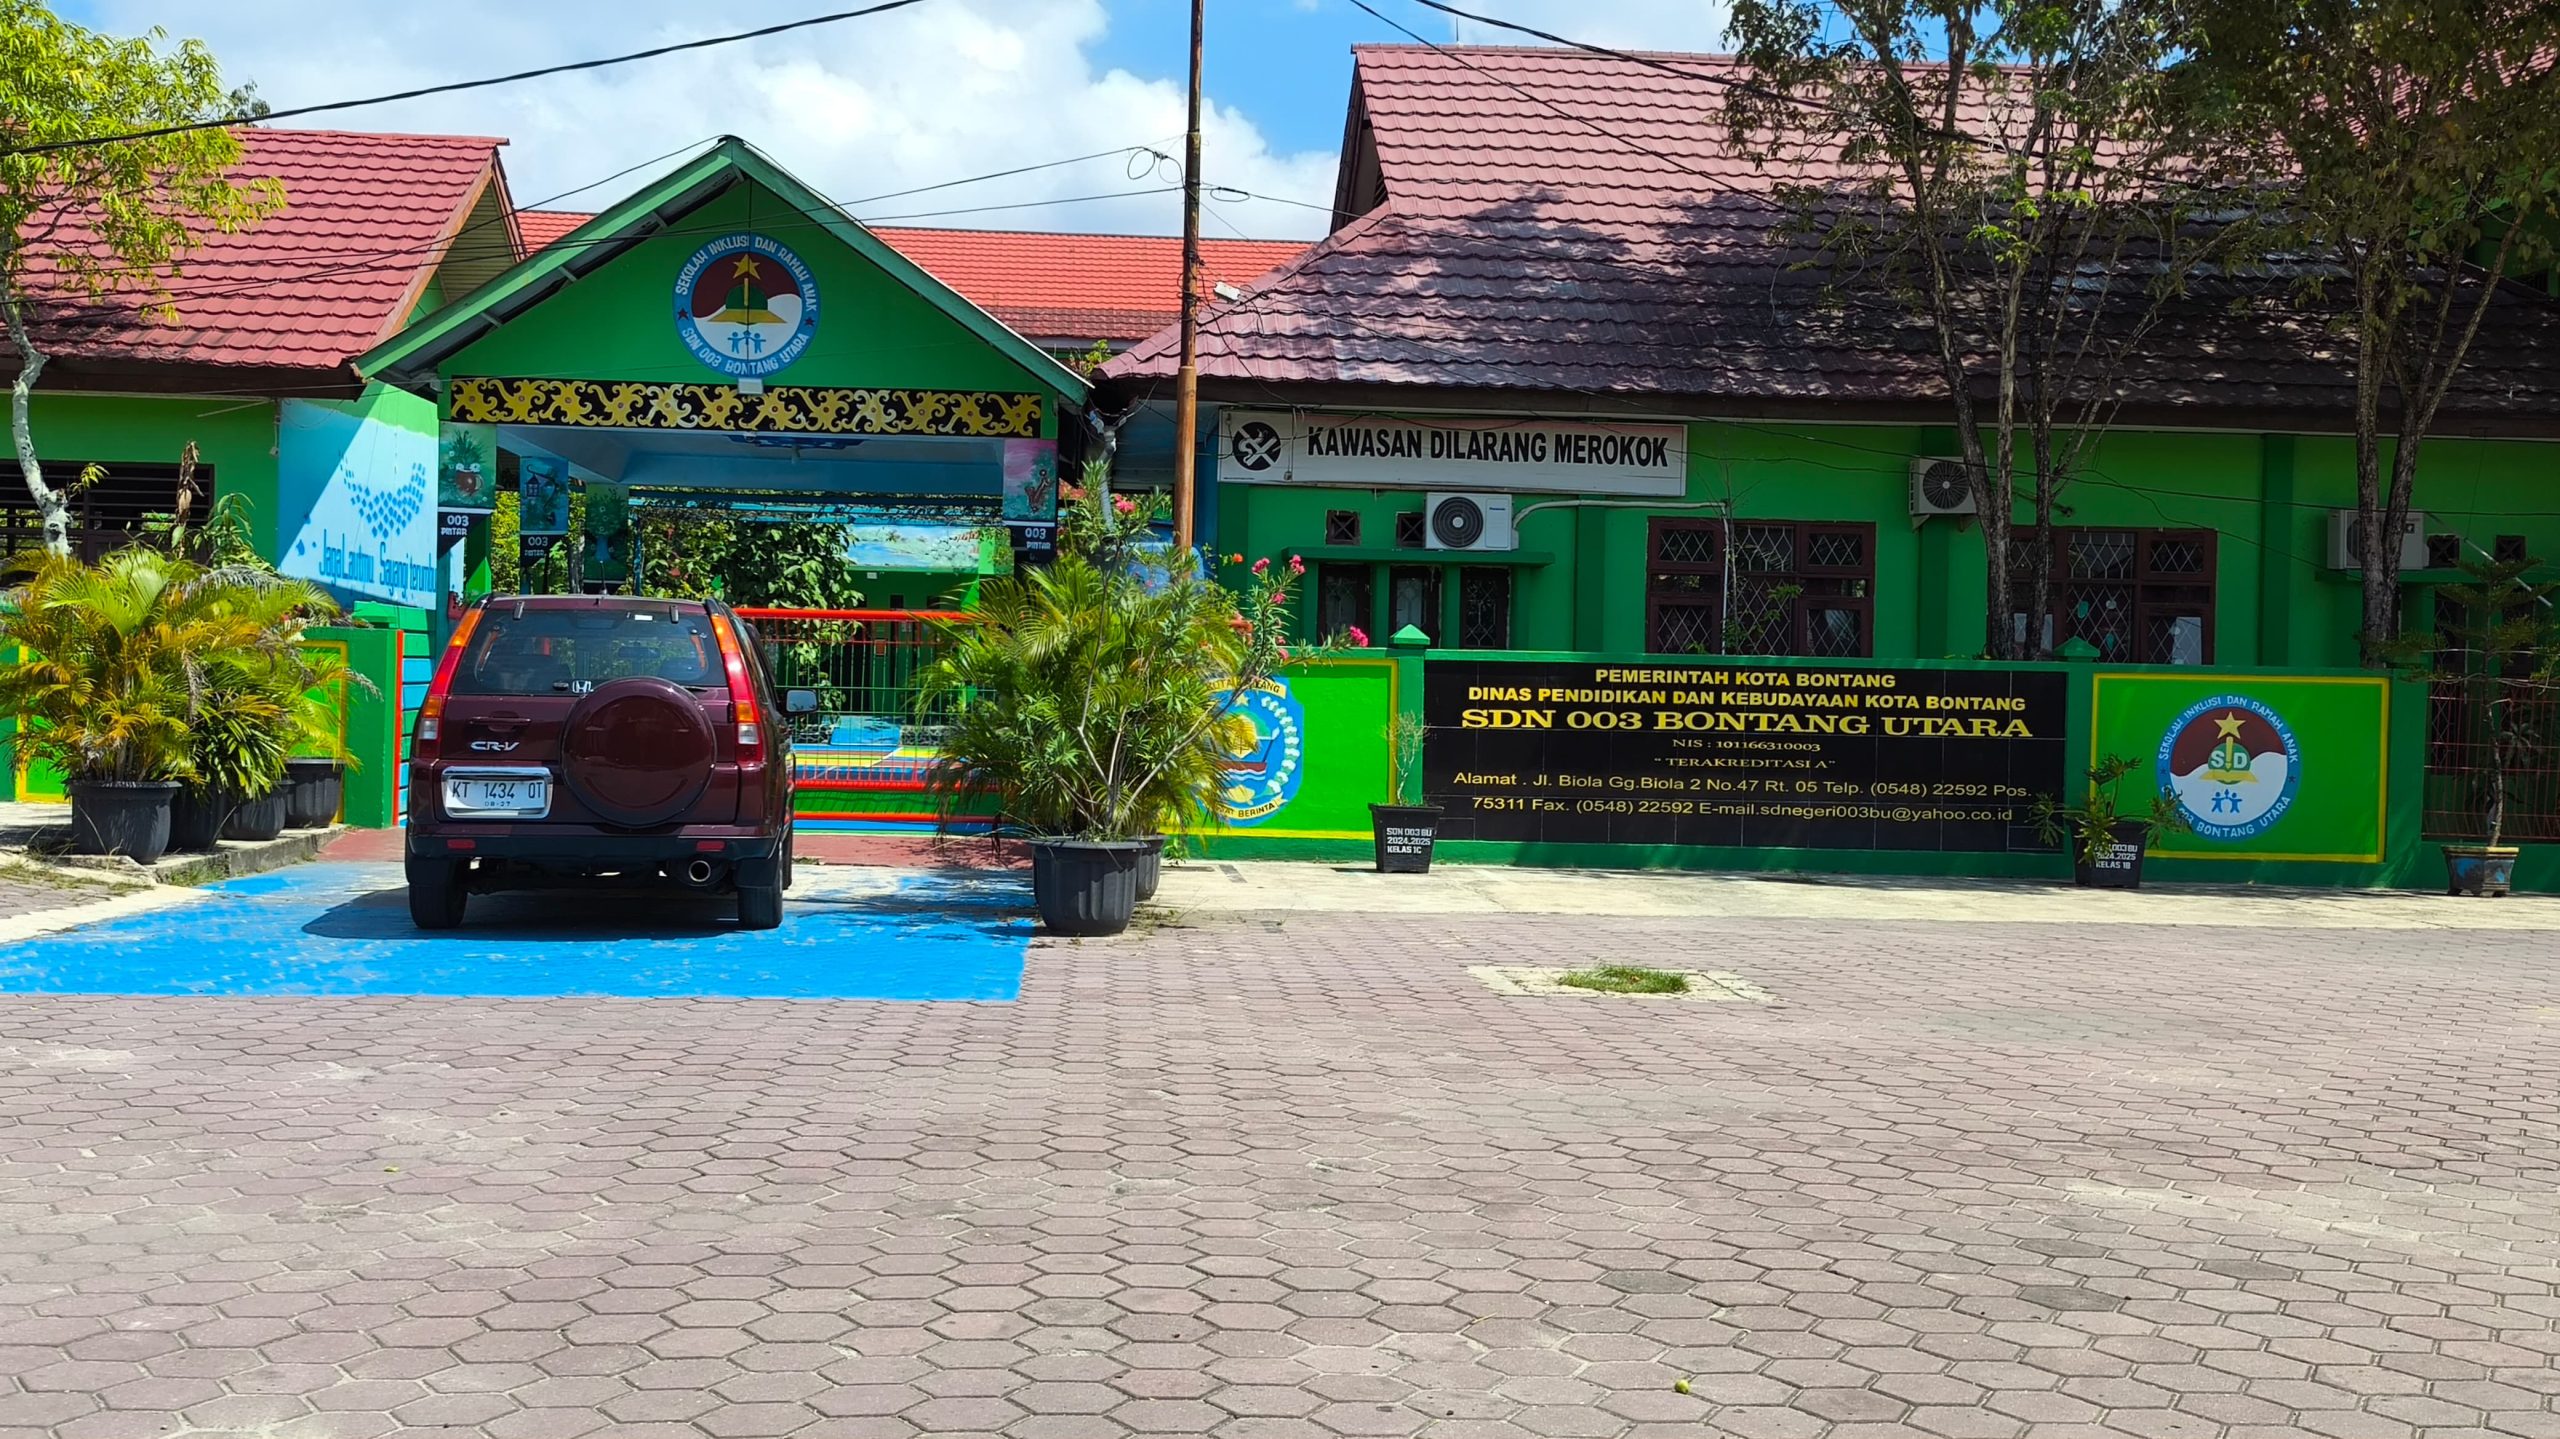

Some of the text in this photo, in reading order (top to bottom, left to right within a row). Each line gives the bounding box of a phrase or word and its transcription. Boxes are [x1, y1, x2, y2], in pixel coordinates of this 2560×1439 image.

[675, 234, 817, 312] SEKOLAH INKLUSI DAN RAMAH ANAK
[681, 327, 810, 375] SDN 003 BONTANG UTARA
[1307, 426, 1669, 468] KAWASAN DILARANG MEROKOK
[447, 515, 469, 527] 003
[528, 536, 548, 547] 003
[1025, 528, 1047, 540] 003
[1595, 669, 1896, 688] PEMERINTAH KOTA BONTANG
[1468, 686, 2026, 711] DINAS PENDIDIKAN DAN KEBUDAYAAN KOTA BONTANG
[1461, 709, 2033, 738] SDN 003 BONTANG UTARA
[2158, 695, 2298, 764] SEKOLAH INKLUSI DAN RAMAH ANAK
[470, 741, 520, 751] CR-V
[1672, 739, 1703, 748] NIS
[1715, 740, 1821, 752] 101166310003
[1665, 757, 1811, 769] TERAKREDITASI
[452, 782, 471, 799] KT
[484, 782, 516, 800] 1434
[1453, 772, 1517, 786] Alamat
[1559, 774, 1603, 788] Biola
[1608, 776, 1685, 793] Gg.Biola
[1690, 778, 1701, 790] 2
[1707, 779, 1759, 792] No.47
[1765, 780, 1789, 793] Rt.
[1795, 780, 1818, 793] 05
[1823, 781, 1864, 796] Telp.
[1870, 782, 1928, 798] (0548)
[1932, 784, 1988, 797] 22592
[1993, 785, 2032, 798] Pos.
[1472, 797, 1525, 811] 75311
[1532, 798, 1570, 812] Fax.
[1576, 799, 1634, 815] (0548)
[1638, 800, 1693, 814] 22592
[2196, 821, 2255, 838] BONTANG
[2258, 796, 2291, 827] UTARA
[1404, 828, 1420, 836] 003
[1387, 845, 1422, 854] KELAS 1C
[2127, 844, 2138, 853] BU
[2095, 861, 2131, 870] KELAS 1B
